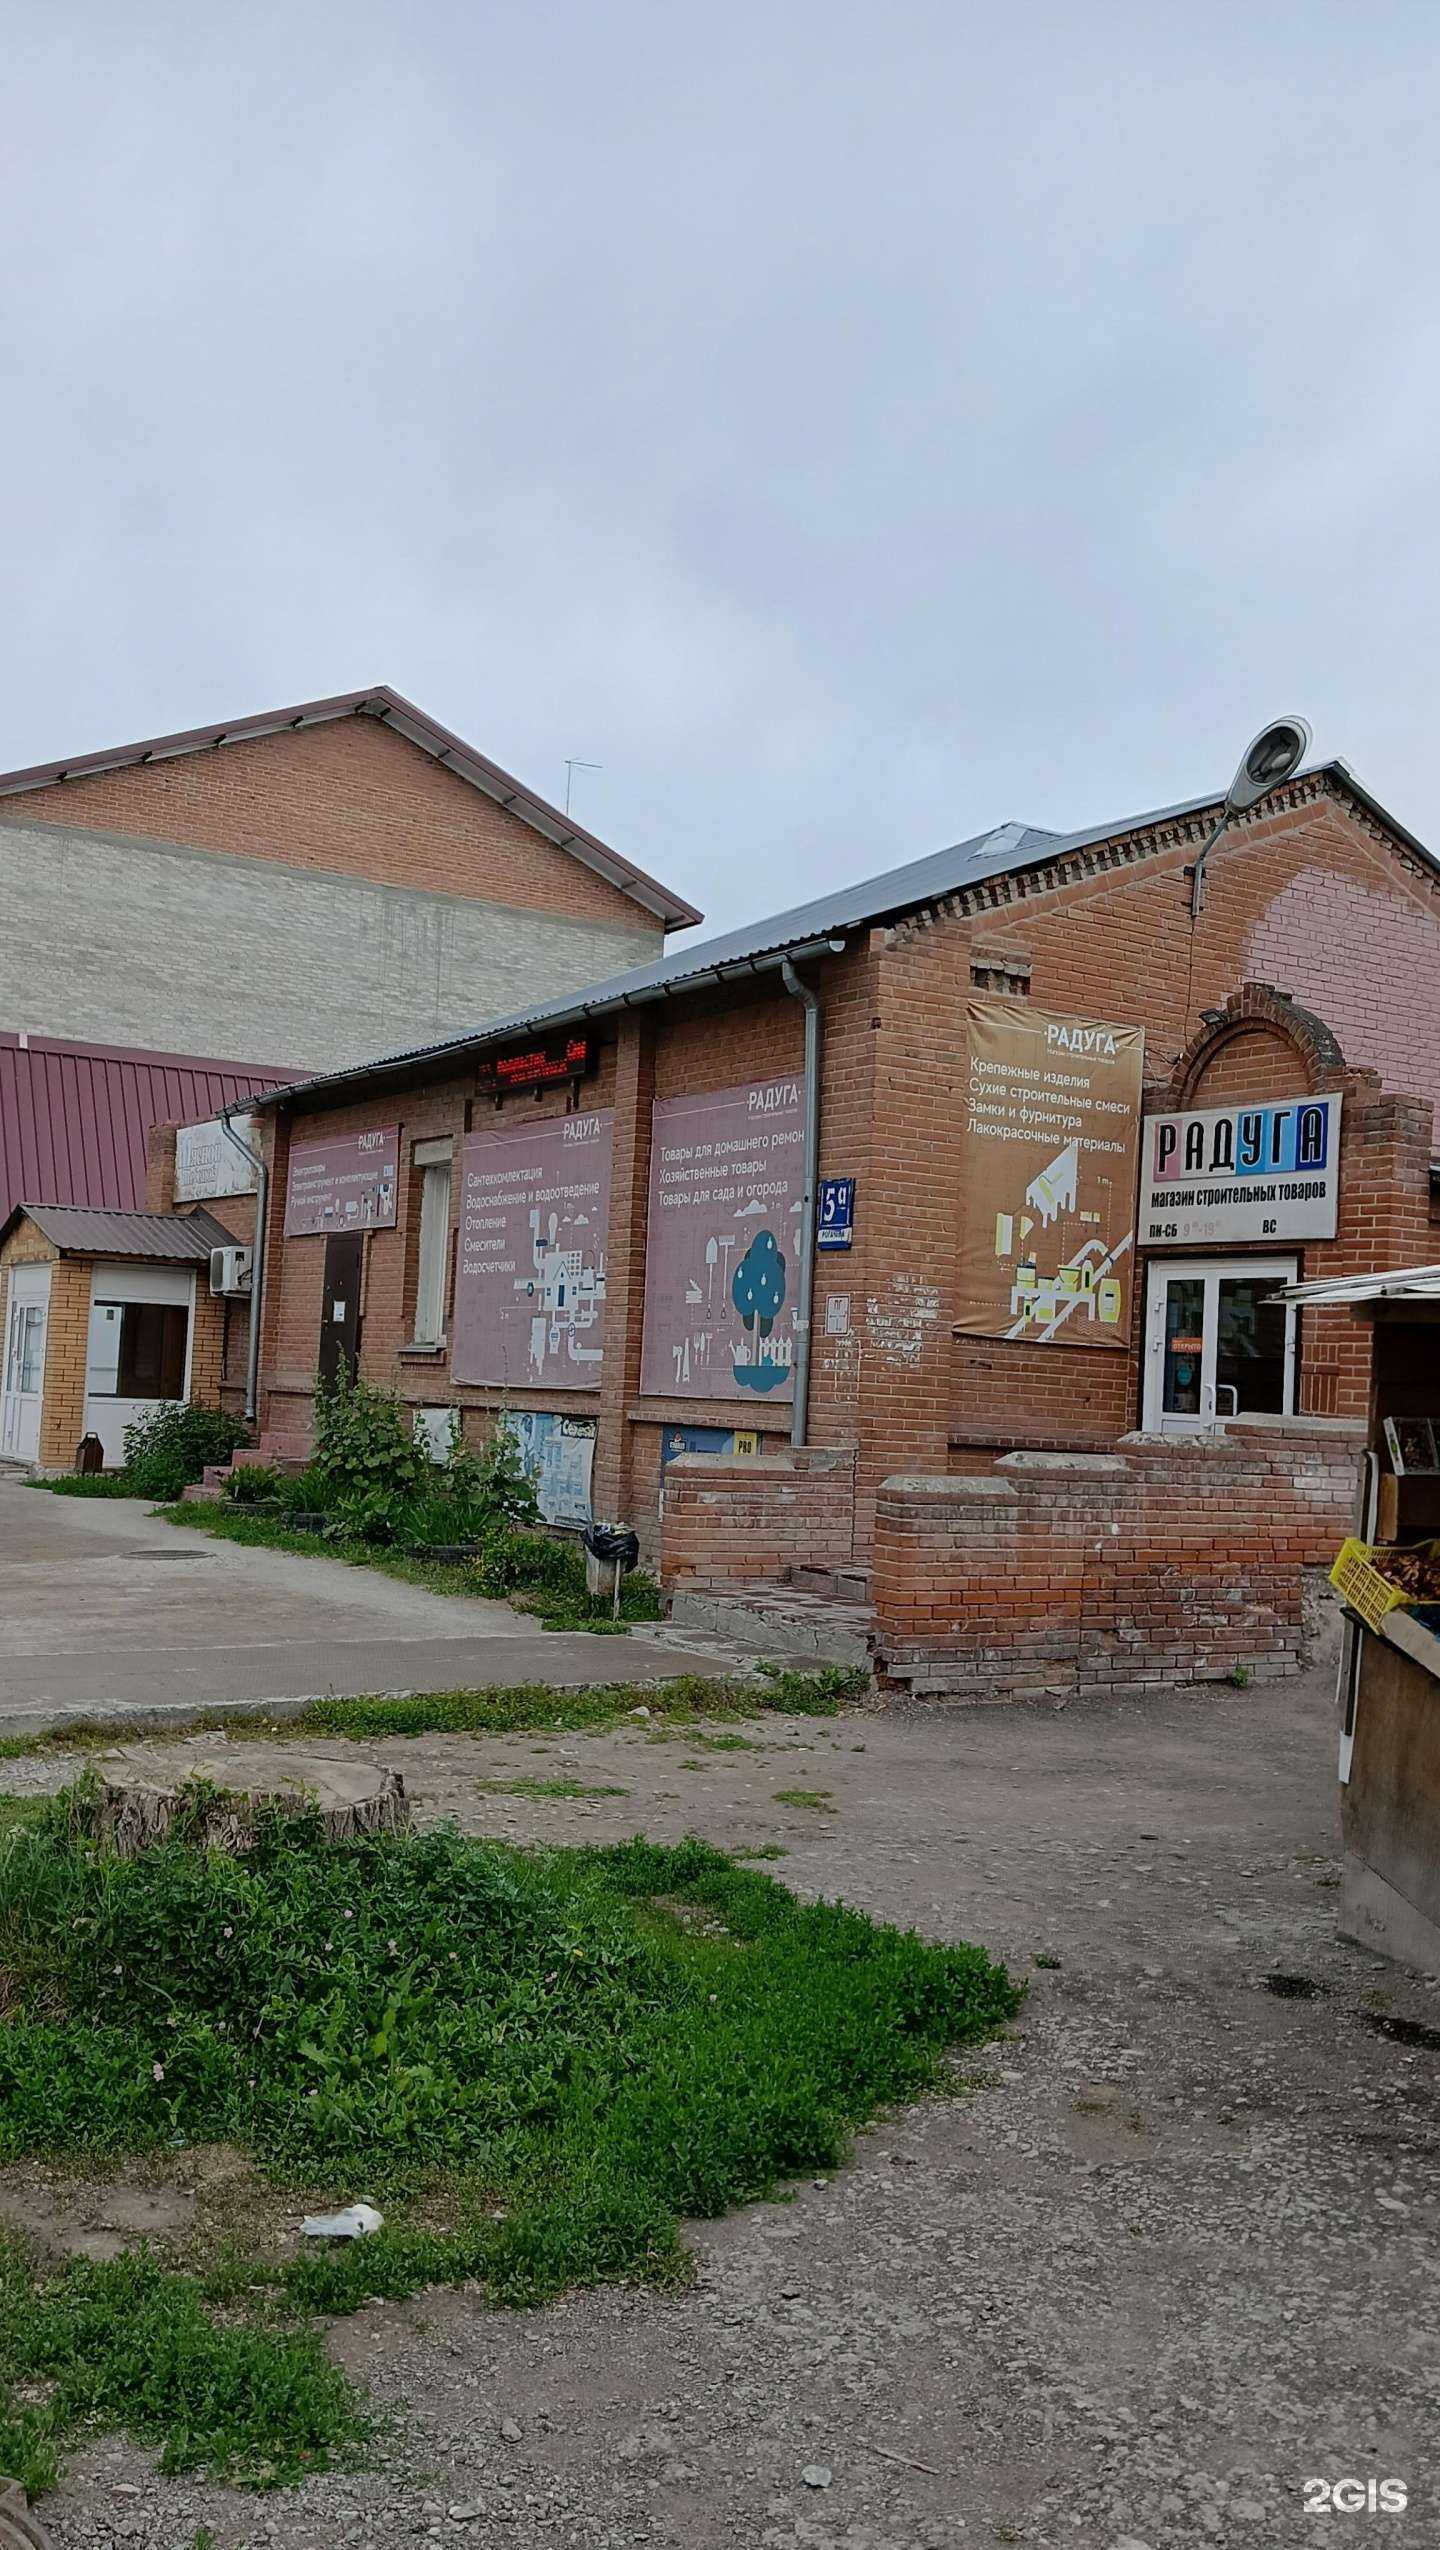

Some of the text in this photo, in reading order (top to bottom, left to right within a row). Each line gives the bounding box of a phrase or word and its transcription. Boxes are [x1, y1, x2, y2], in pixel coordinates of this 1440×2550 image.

[1047, 1024, 1116, 1055] РАДУГА
[970, 1056, 1041, 1080] Крепежные
[1043, 1073, 1090, 1089] изделия
[748, 1083, 798, 1112] РАДУГА
[969, 1077, 1131, 1114] Сухие строительные смеси
[967, 1098, 1082, 1130] Замки и фурнитура
[358, 1131, 384, 1150] РАДУГА
[563, 1117, 600, 1141] РАДУГА
[966, 1118, 1126, 1153] Лакокрасочные материалы
[1157, 1107, 1323, 1175] РАДУГА
[660, 1129, 805, 1163] Товары для домашнего ремон
[659, 1159, 767, 1185] Хозяйственные товары
[466, 1181, 600, 1209] Водоснабжение и водоотведение
[658, 1180, 788, 1207] Товары для сада и огорода
[1196, 1184, 1277, 1207] строительных
[1278, 1181, 1327, 1202] товаров
[465, 1214, 507, 1231] Отопление
[1149, 1223, 1178, 1238] ПН-СБ
[1262, 1219, 1277, 1233] ВС
[464, 1238, 506, 1252] Смесители
[463, 1259, 516, 1275] Водосчетчики
